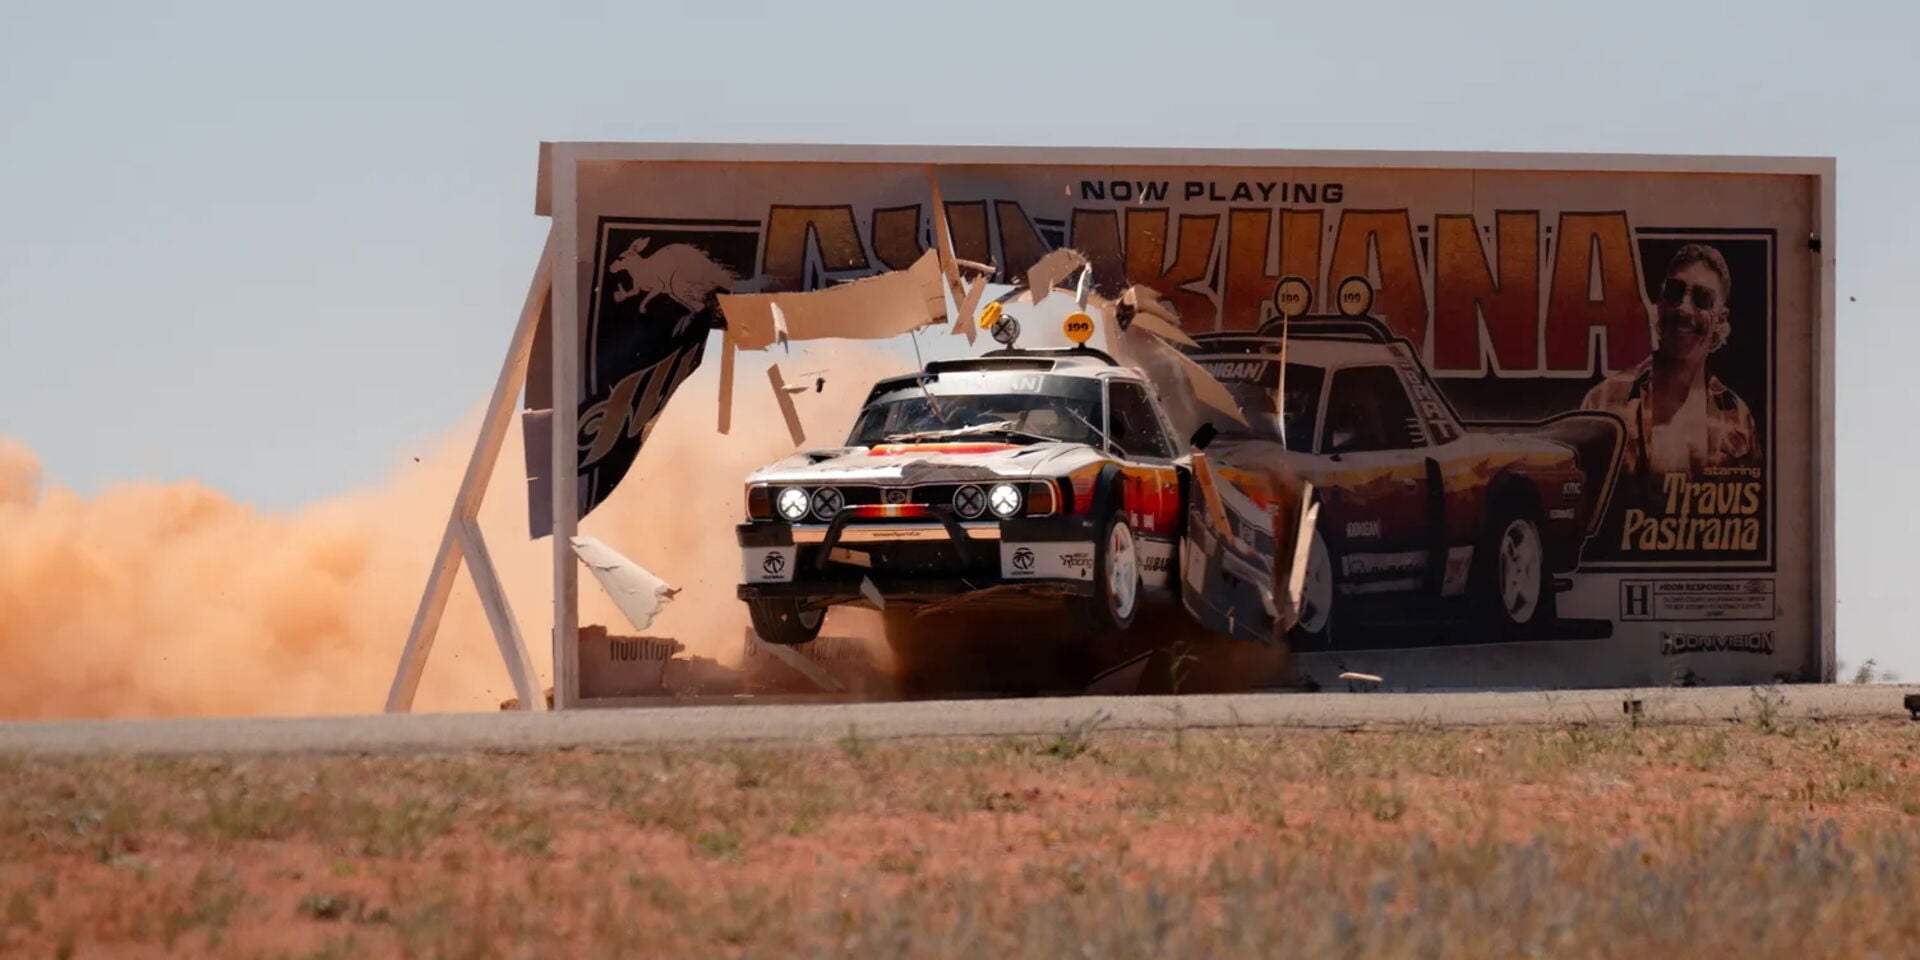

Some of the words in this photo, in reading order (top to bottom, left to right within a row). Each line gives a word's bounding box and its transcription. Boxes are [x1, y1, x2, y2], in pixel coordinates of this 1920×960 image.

[1080, 180, 1170, 201] NOW
[1184, 181, 1344, 204] PLAYING
[1067, 322, 1089, 333] 199
[1703, 465, 1761, 478] starring
[1663, 472, 1761, 515] Travis
[1620, 508, 1761, 551] Pastrana
[1624, 585, 1649, 616] H
